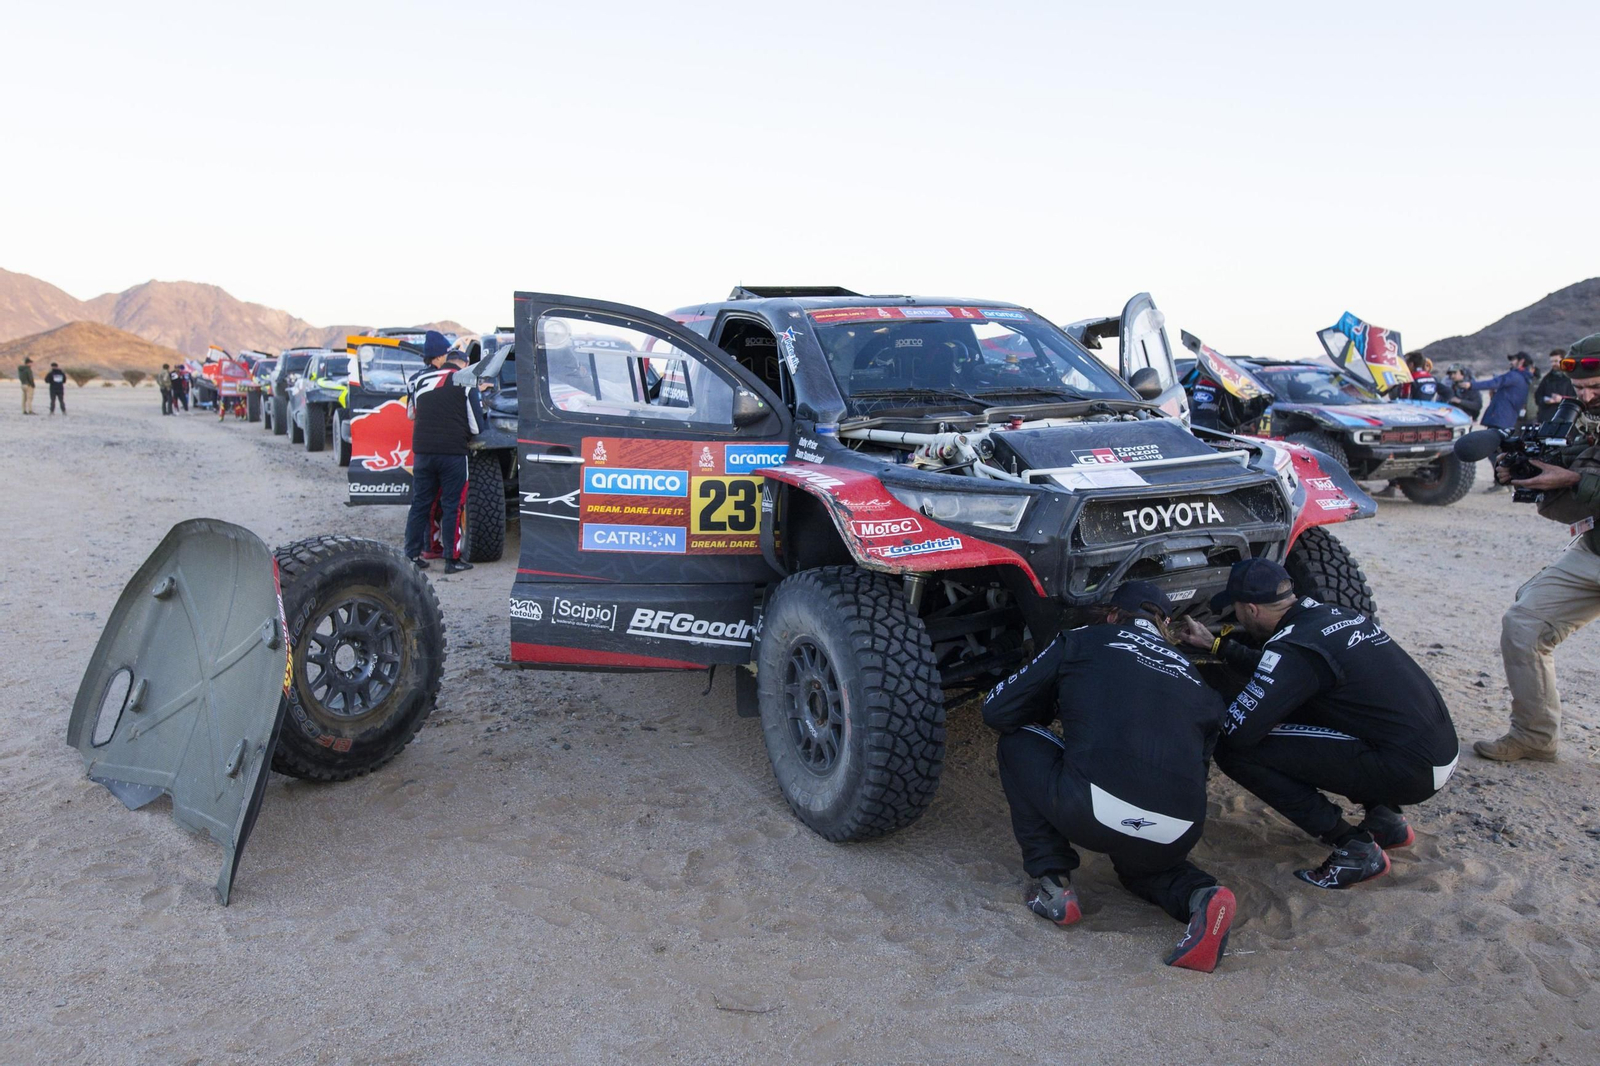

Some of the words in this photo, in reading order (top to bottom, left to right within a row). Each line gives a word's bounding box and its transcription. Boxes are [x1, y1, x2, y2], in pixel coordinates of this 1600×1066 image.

[984, 311, 1023, 319] aramco
[1113, 444, 1159, 453] TOYOTA
[348, 482, 410, 493] Goodrich
[591, 473, 680, 491] aramco
[587, 505, 622, 513] DREAM.
[1123, 502, 1224, 533] TOYOTA
[861, 521, 912, 535] MoTeC
[594, 531, 676, 547] CATRION
